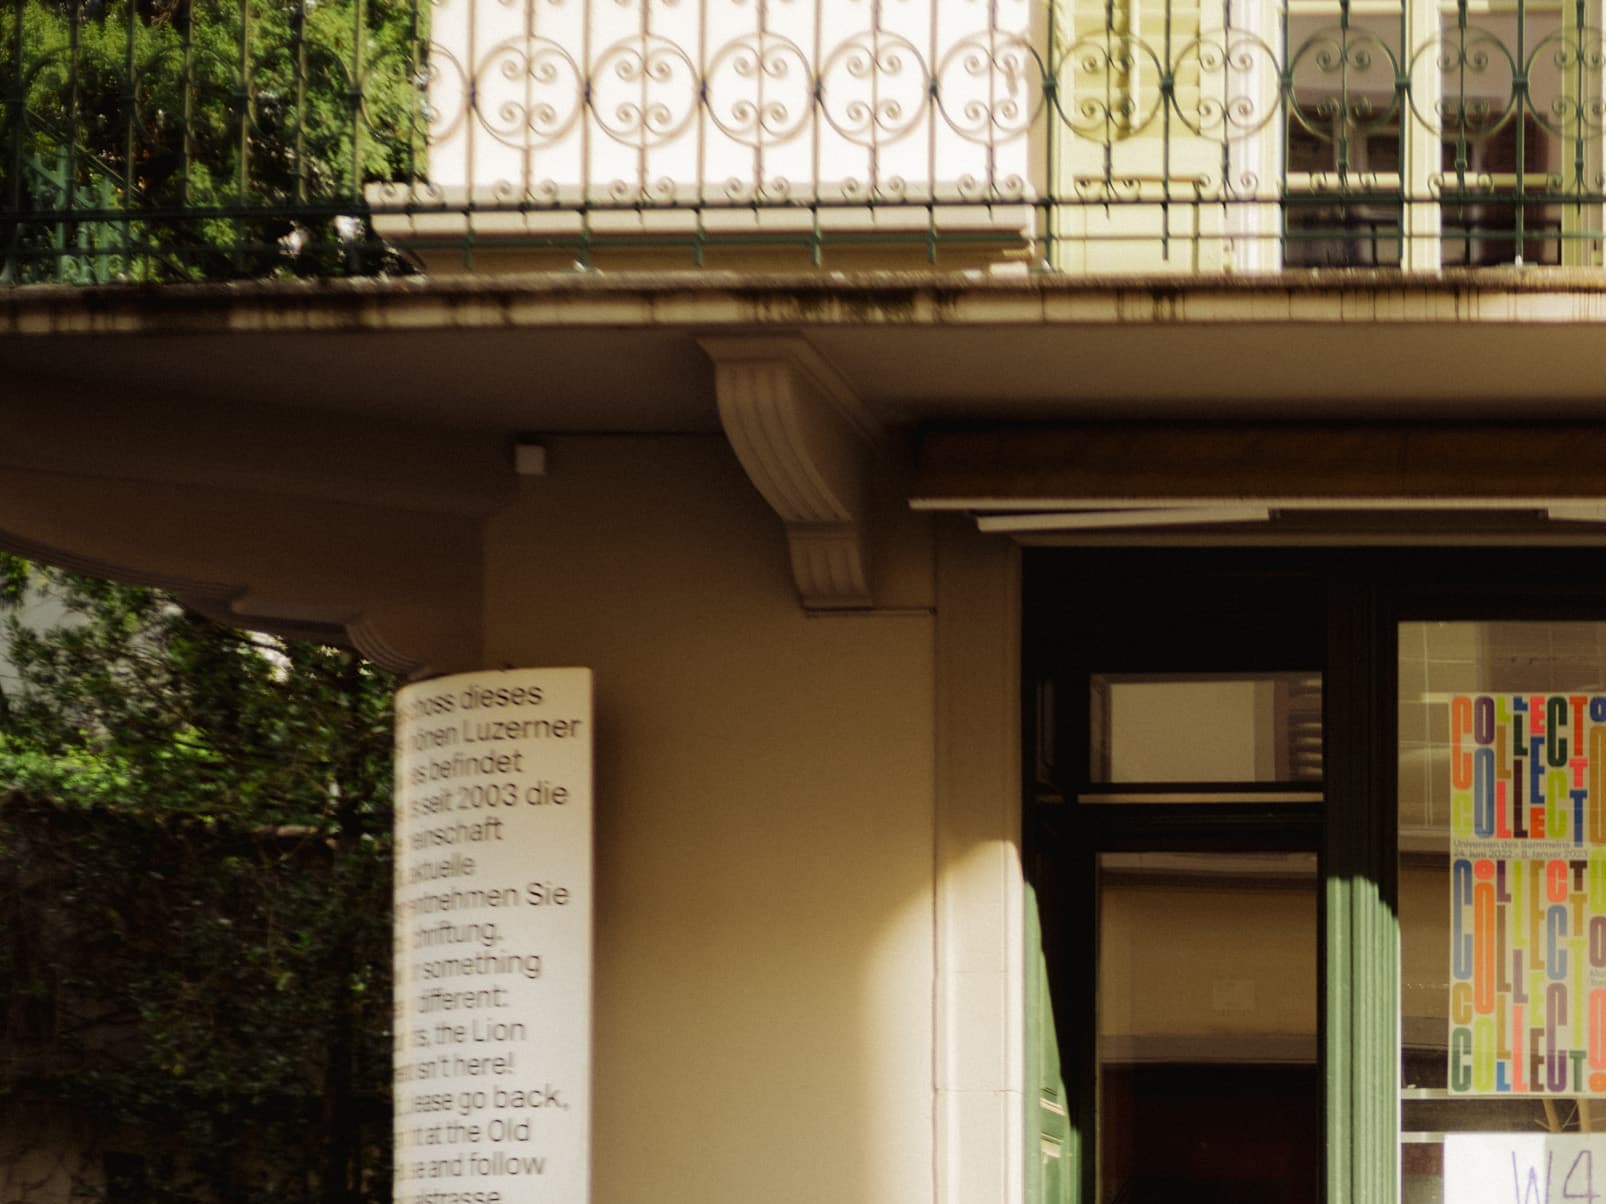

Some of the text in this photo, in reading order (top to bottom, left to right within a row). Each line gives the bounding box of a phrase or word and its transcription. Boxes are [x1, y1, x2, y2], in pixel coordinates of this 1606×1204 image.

[459, 683, 544, 711] dieses
[463, 718, 582, 742] Luzerner
[430, 749, 524, 780] befindet
[458, 782, 519, 809] 2003
[526, 779, 570, 806] die
[527, 880, 571, 906] Sie
[423, 950, 543, 979] something
[434, 1022, 467, 1045] the
[472, 1017, 528, 1042] Lion
[453, 1051, 515, 1077] here!
[459, 1090, 488, 1117] go
[446, 1119, 482, 1143] the
[487, 1116, 532, 1142] Old
[429, 1153, 463, 1177] and
[469, 1150, 547, 1176] follow
